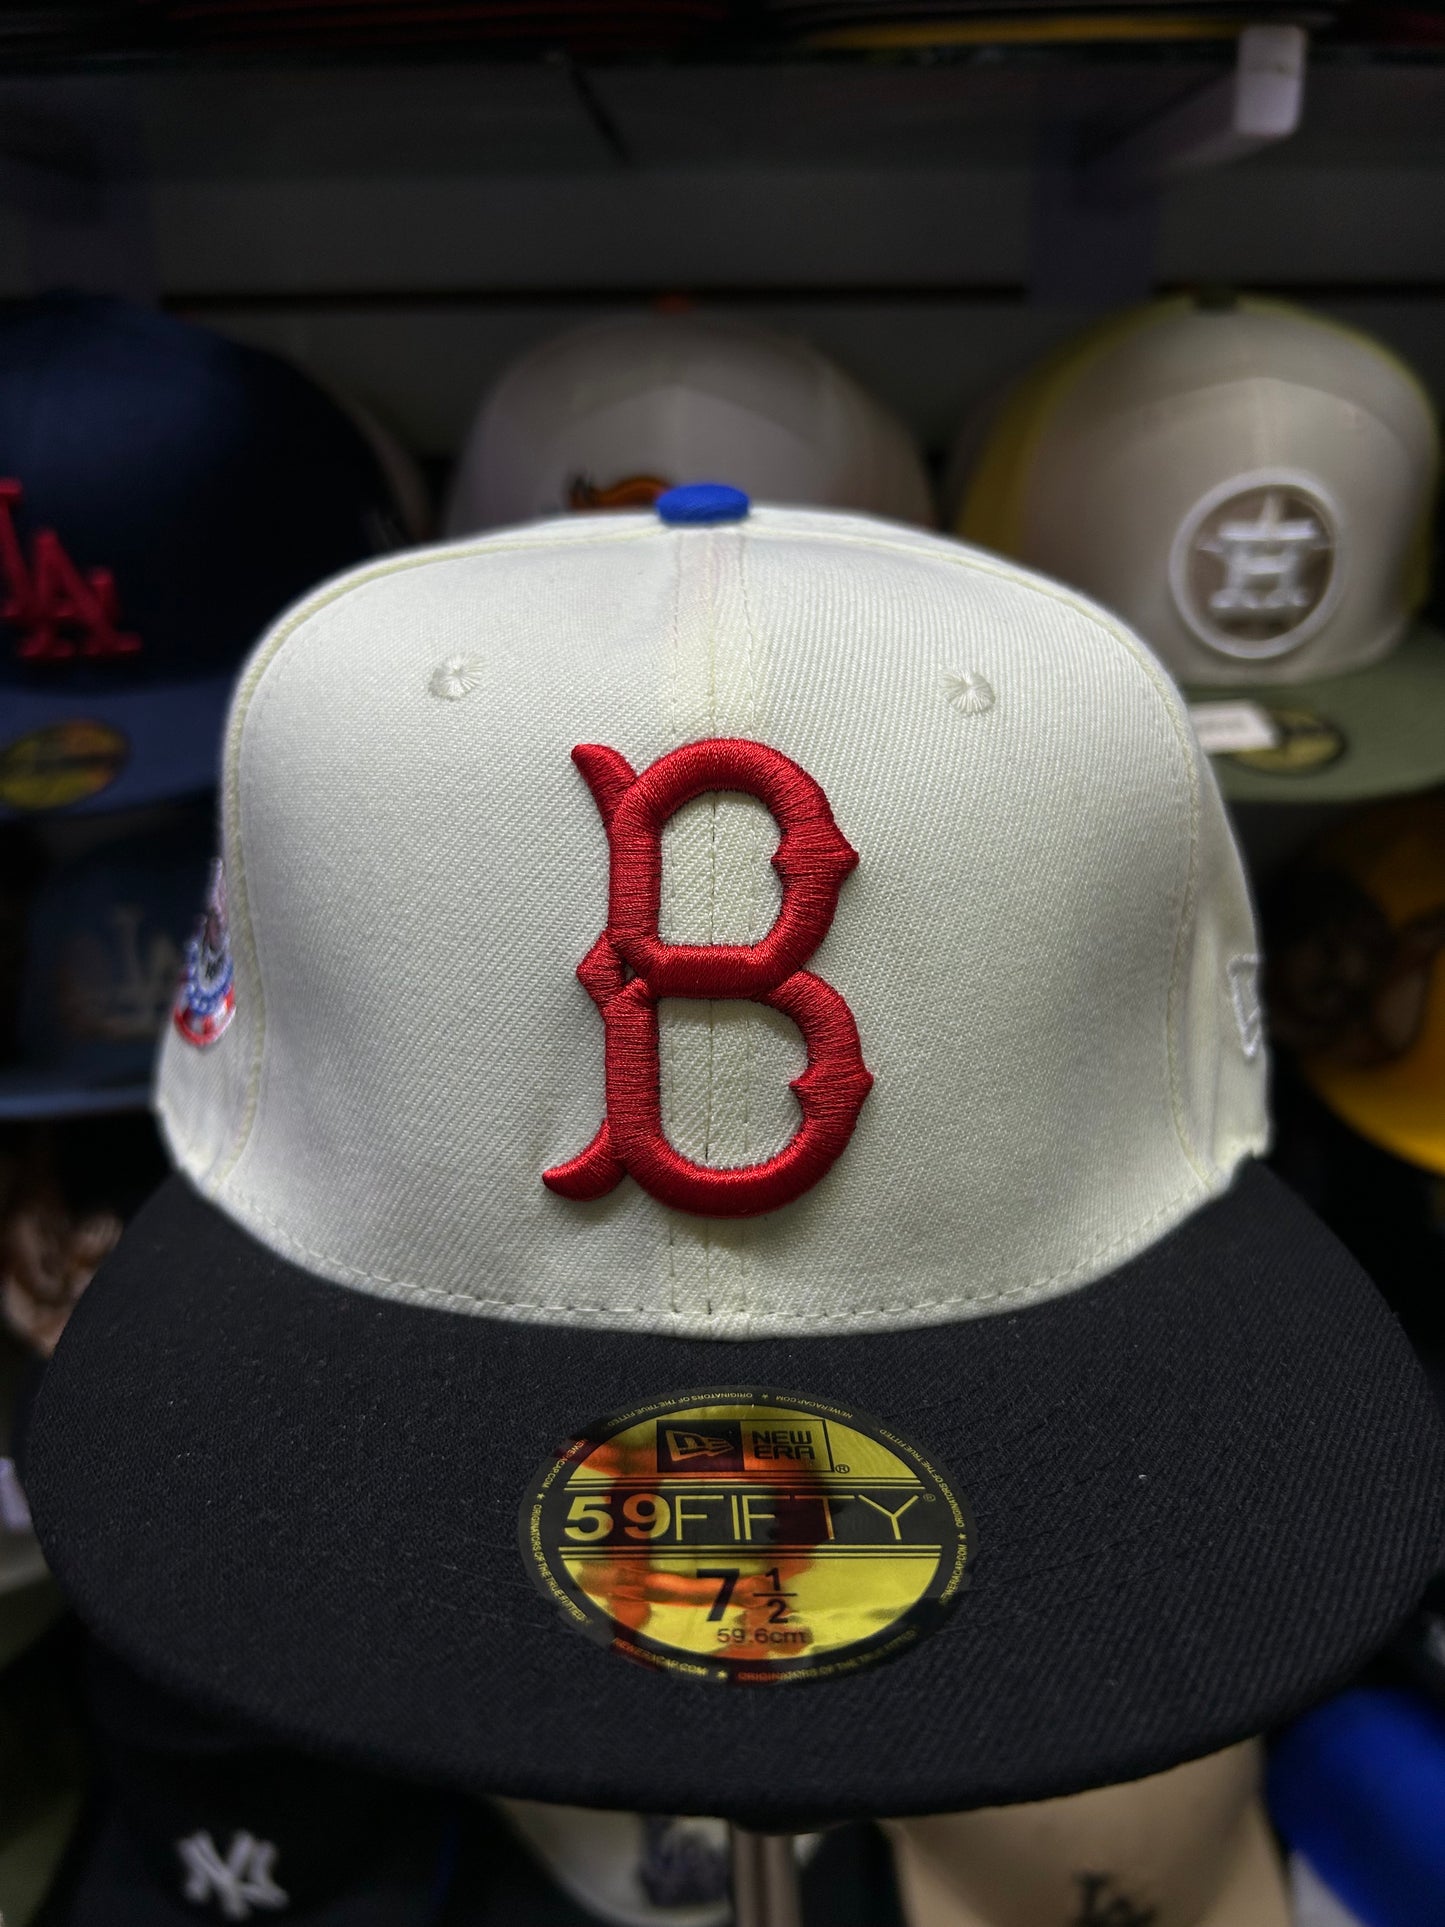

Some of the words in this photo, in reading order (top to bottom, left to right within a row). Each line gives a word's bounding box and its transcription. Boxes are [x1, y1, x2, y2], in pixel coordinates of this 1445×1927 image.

[541, 737, 874, 1219] B
[658, 1398, 677, 1409] THE
[678, 1396, 690, 1404] OF
[691, 1392, 753, 1401] ORIGINATORS
[634, 1403, 659, 1415] TRUE
[752, 1430, 813, 1445] NEW
[754, 1445, 816, 1460] ERA
[939, 1482, 966, 1528] ORIGINATORS
[563, 1492, 920, 1541] 59FIFTY
[696, 1568, 740, 1622] 7
[717, 1627, 812, 1644] 59.6cm
